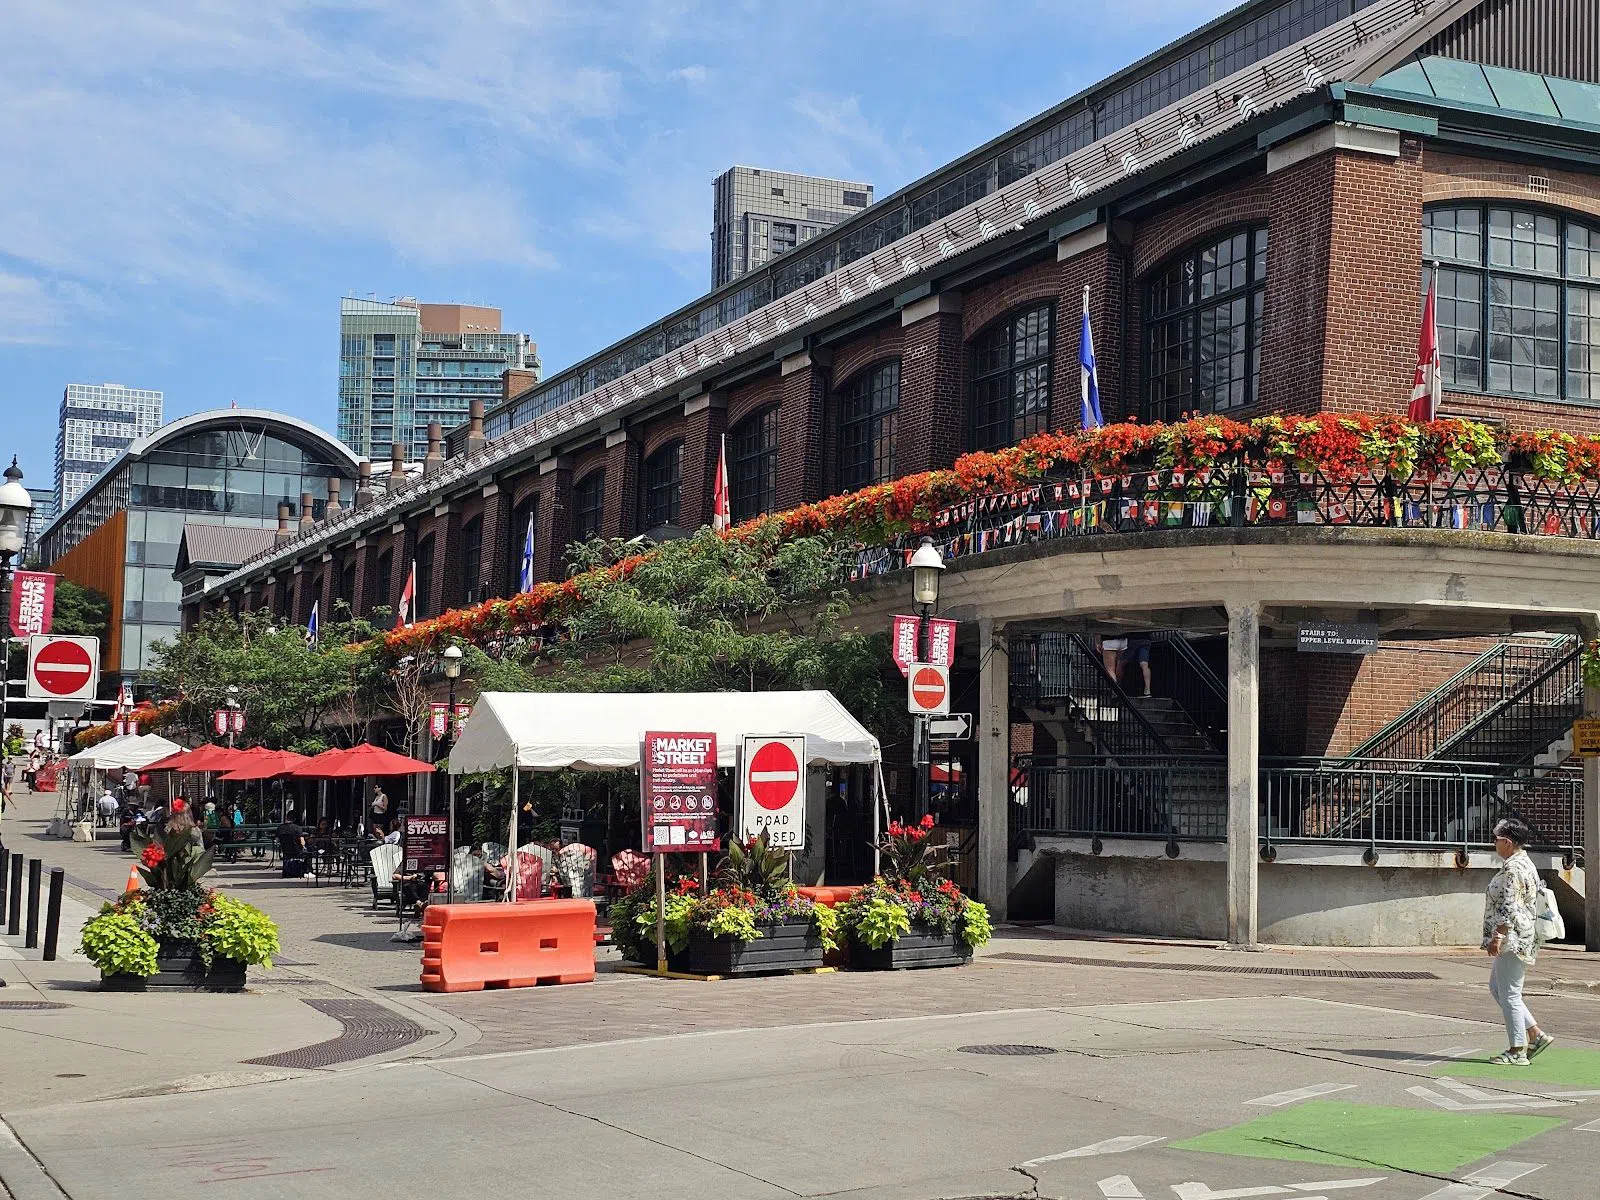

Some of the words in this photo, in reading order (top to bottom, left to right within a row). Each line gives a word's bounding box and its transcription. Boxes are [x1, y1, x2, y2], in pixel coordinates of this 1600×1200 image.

[18, 581, 33, 632] STREET
[899, 623, 907, 662] STREET
[940, 626, 950, 664] MARKE
[656, 738, 712, 752] MARKET
[656, 752, 707, 764] STREET
[756, 814, 790, 826] ROAD
[407, 824, 447, 834] STAGE
